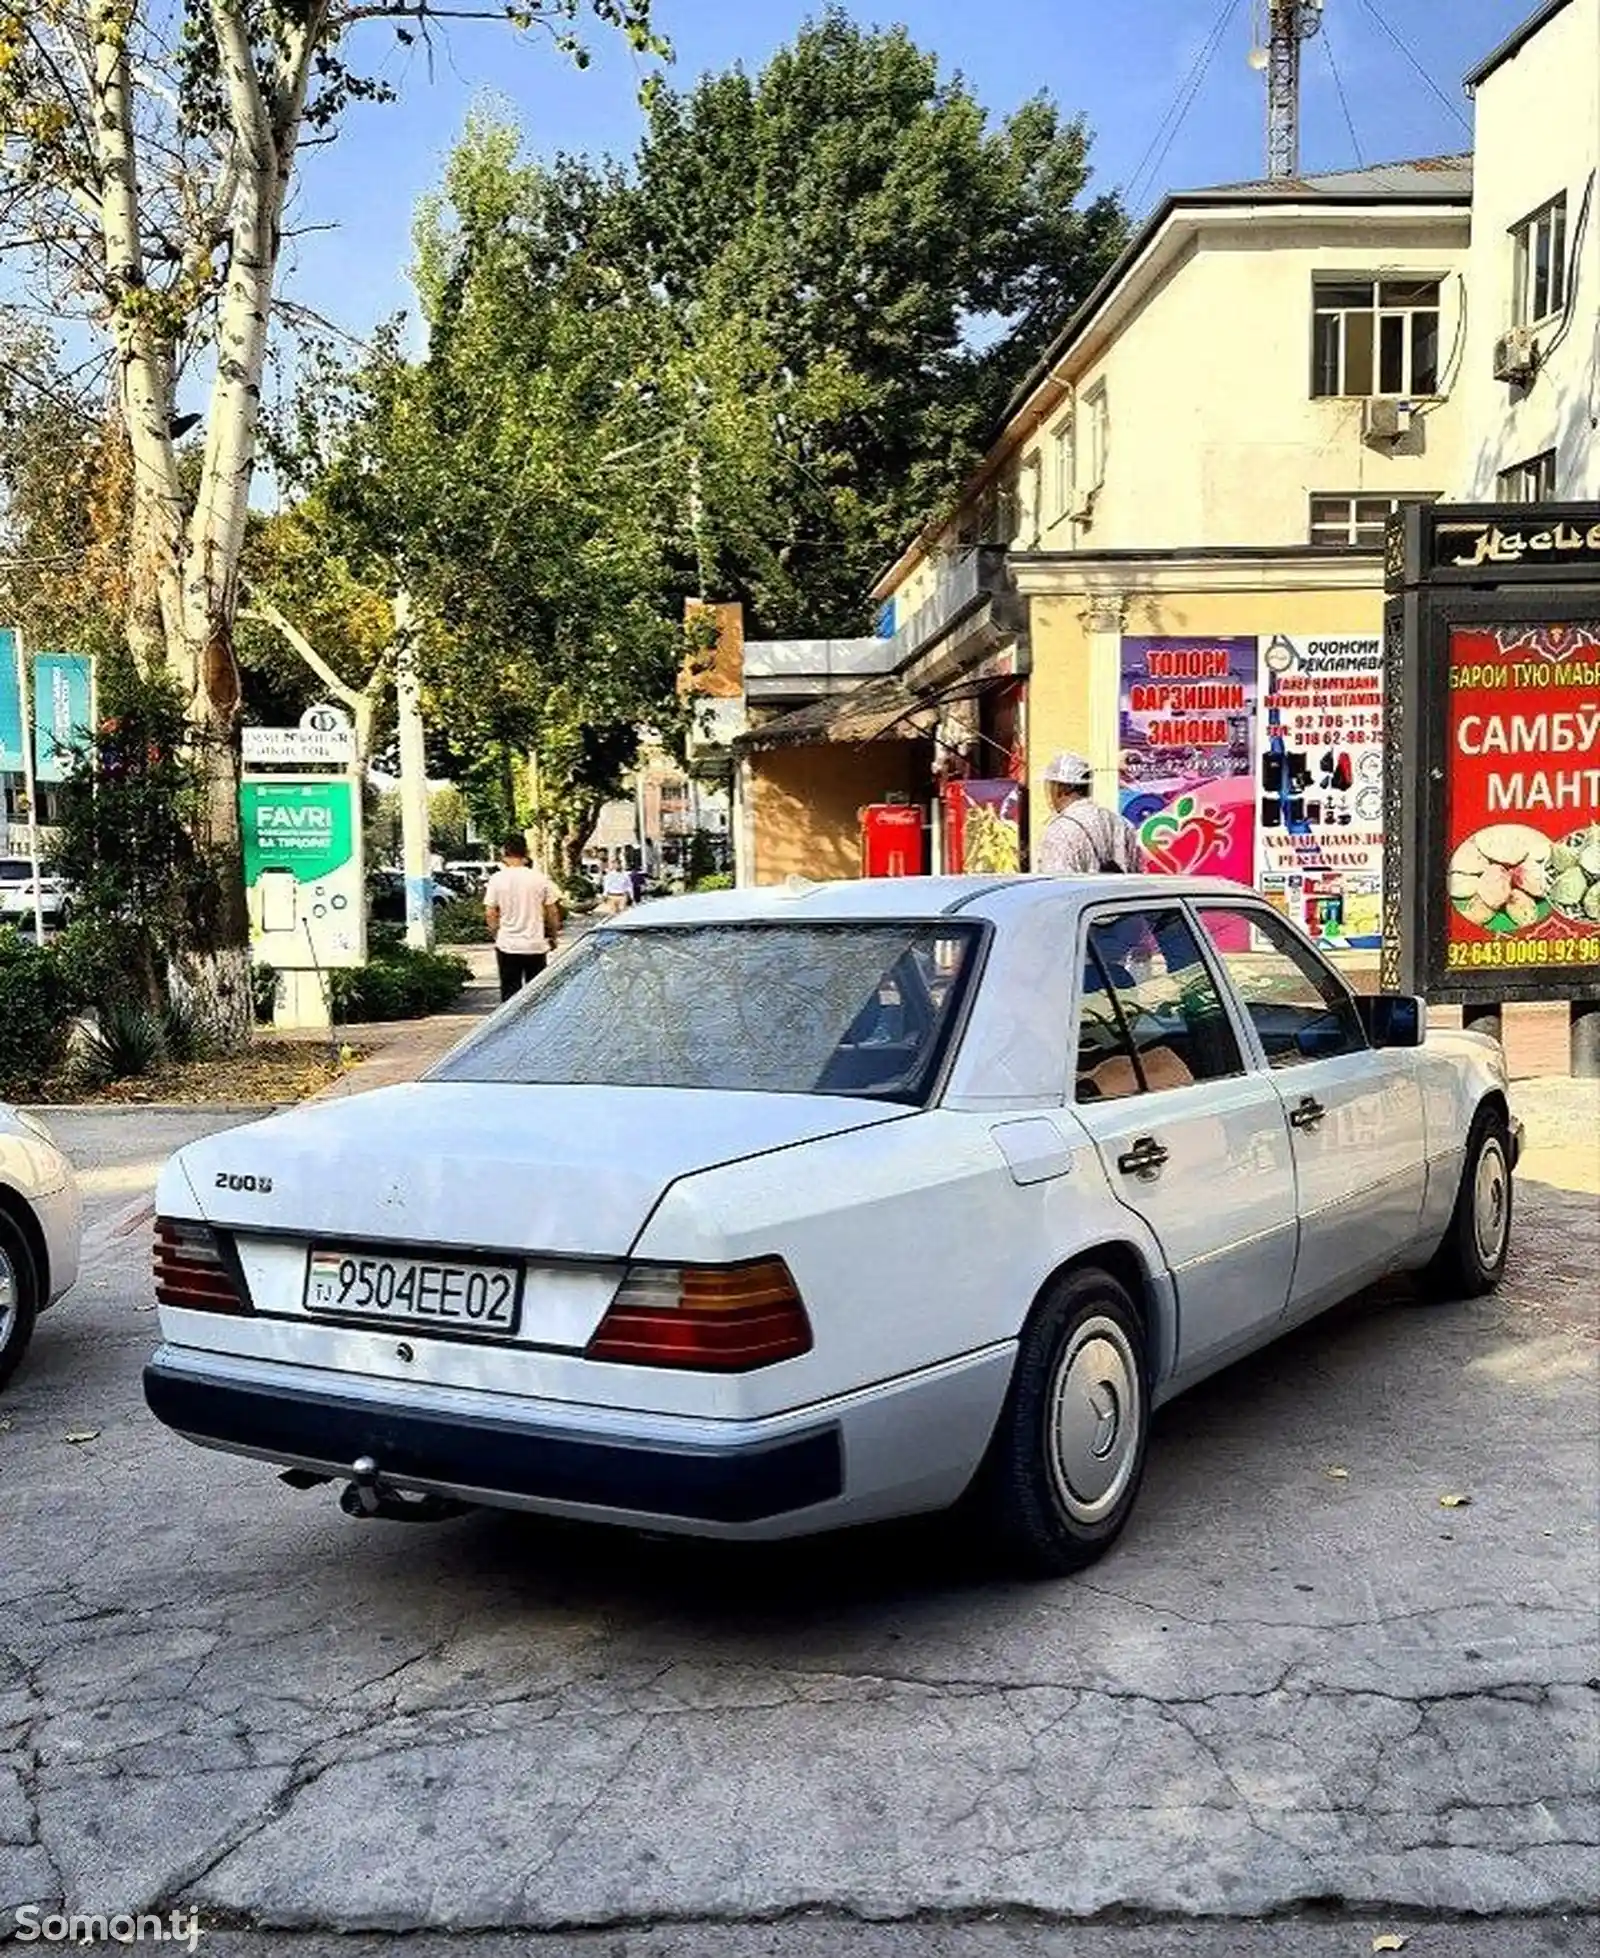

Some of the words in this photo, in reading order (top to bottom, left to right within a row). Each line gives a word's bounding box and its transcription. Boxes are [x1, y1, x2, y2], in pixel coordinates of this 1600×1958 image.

[1147, 650, 1229, 677] ТОЛОРИ
[1449, 664, 1508, 688] БАРОИ
[1130, 683, 1245, 712] ВАРЗИШИИ
[1147, 718, 1229, 746] ЗАНОНА
[257, 806, 332, 828] FAVRI
[316, 1283, 333, 1302] TJ
[337, 1259, 514, 1322] 9504EE02
